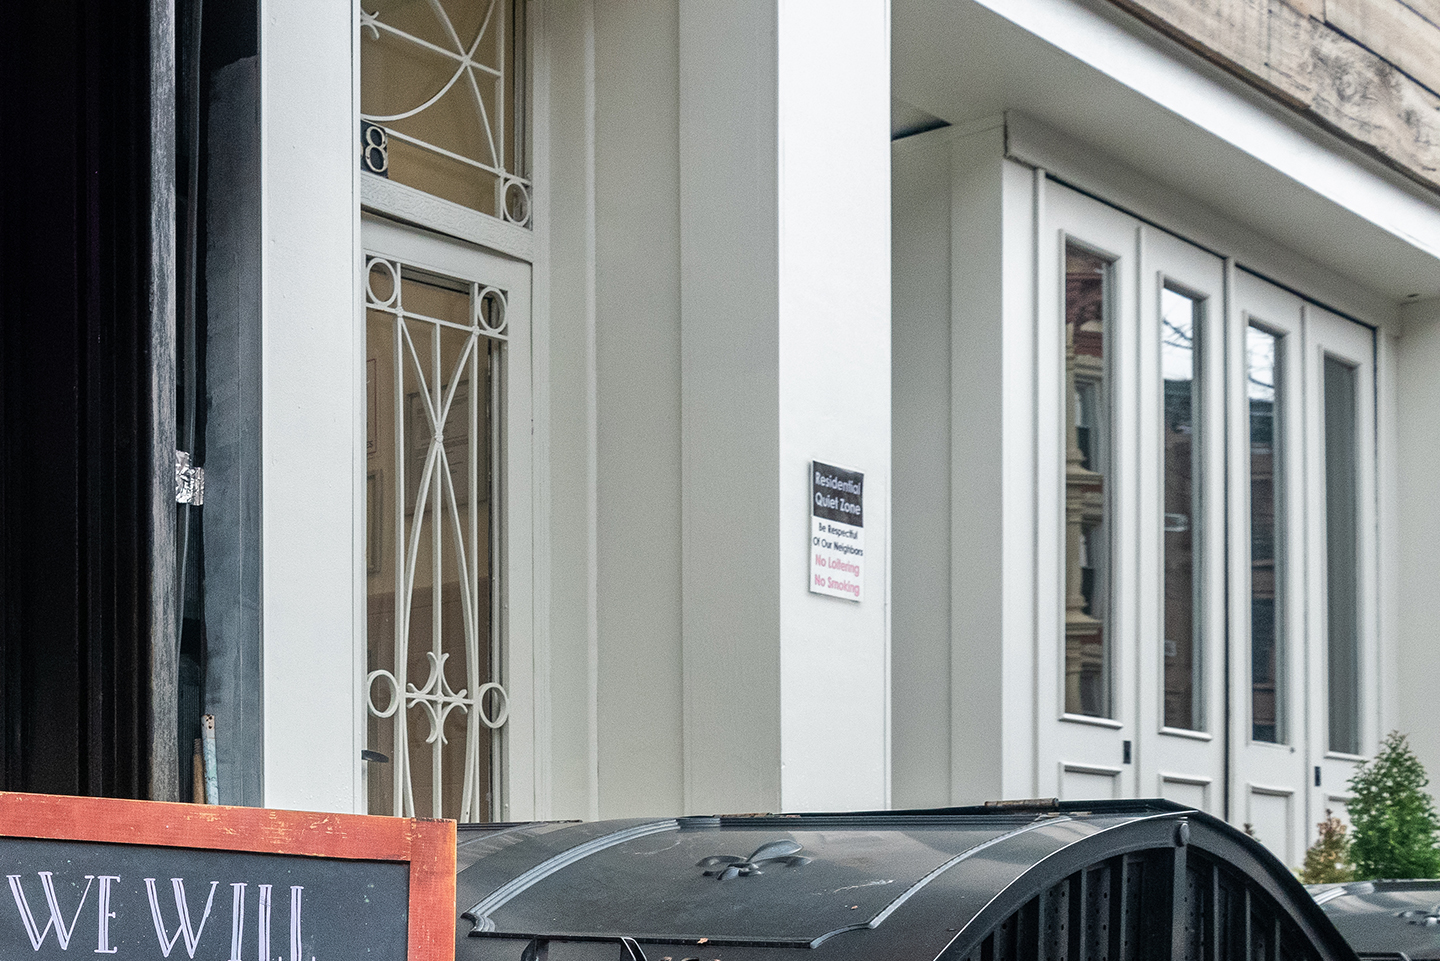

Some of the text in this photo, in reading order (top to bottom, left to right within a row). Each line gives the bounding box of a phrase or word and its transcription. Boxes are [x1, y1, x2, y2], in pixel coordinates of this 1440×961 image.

[815, 471, 861, 495] Residential
[815, 492, 861, 515] Quiet Zone
[819, 522, 858, 540] Be Respectful
[813, 537, 863, 556] Of Our Neighbors
[815, 554, 860, 577] No Loitering
[815, 574, 860, 597] No Smoking
[6, 871, 121, 953] WE
